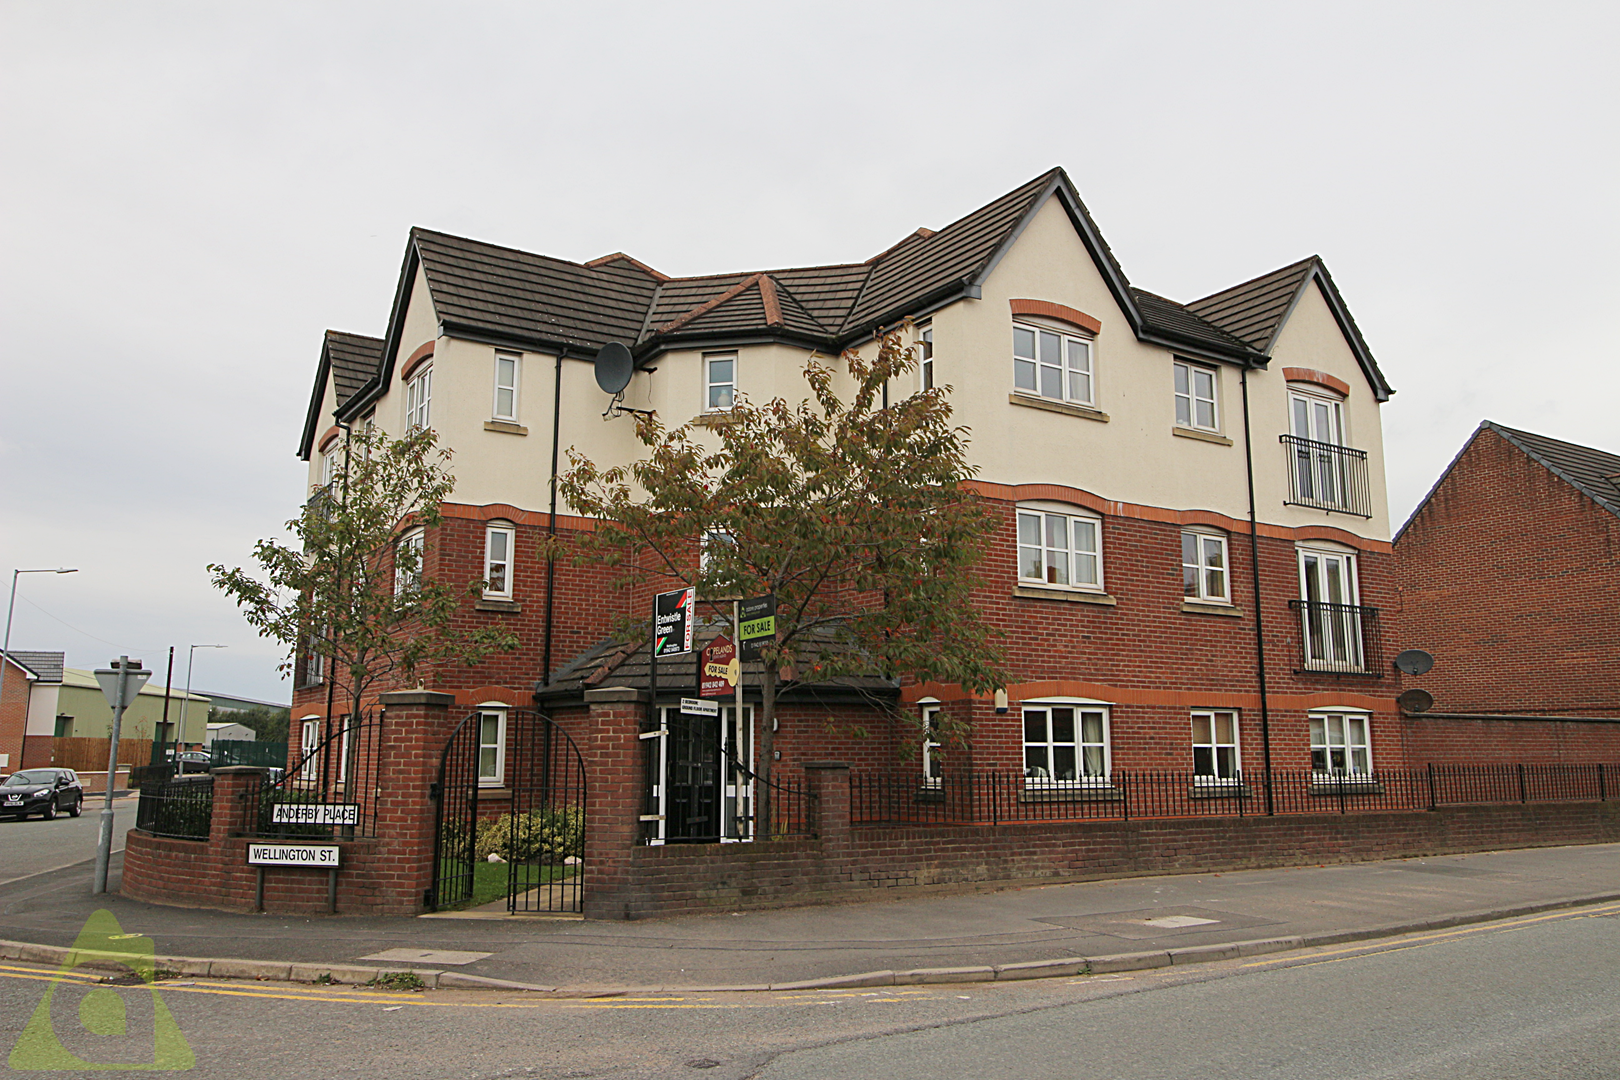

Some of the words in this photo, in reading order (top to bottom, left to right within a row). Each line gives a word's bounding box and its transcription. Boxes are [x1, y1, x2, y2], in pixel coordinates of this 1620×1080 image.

[657, 612, 681, 625] Entwistle
[657, 625, 673, 635] Green
[743, 624, 756, 636] FOR
[756, 621, 771, 633] SALE
[708, 665, 718, 673] FOR
[717, 666, 728, 675] SALE
[275, 808, 320, 820] ANDERBY
[324, 808, 355, 821] PLACE
[253, 848, 316, 862] WELLINGTON
[319, 850, 335, 862] ST.
